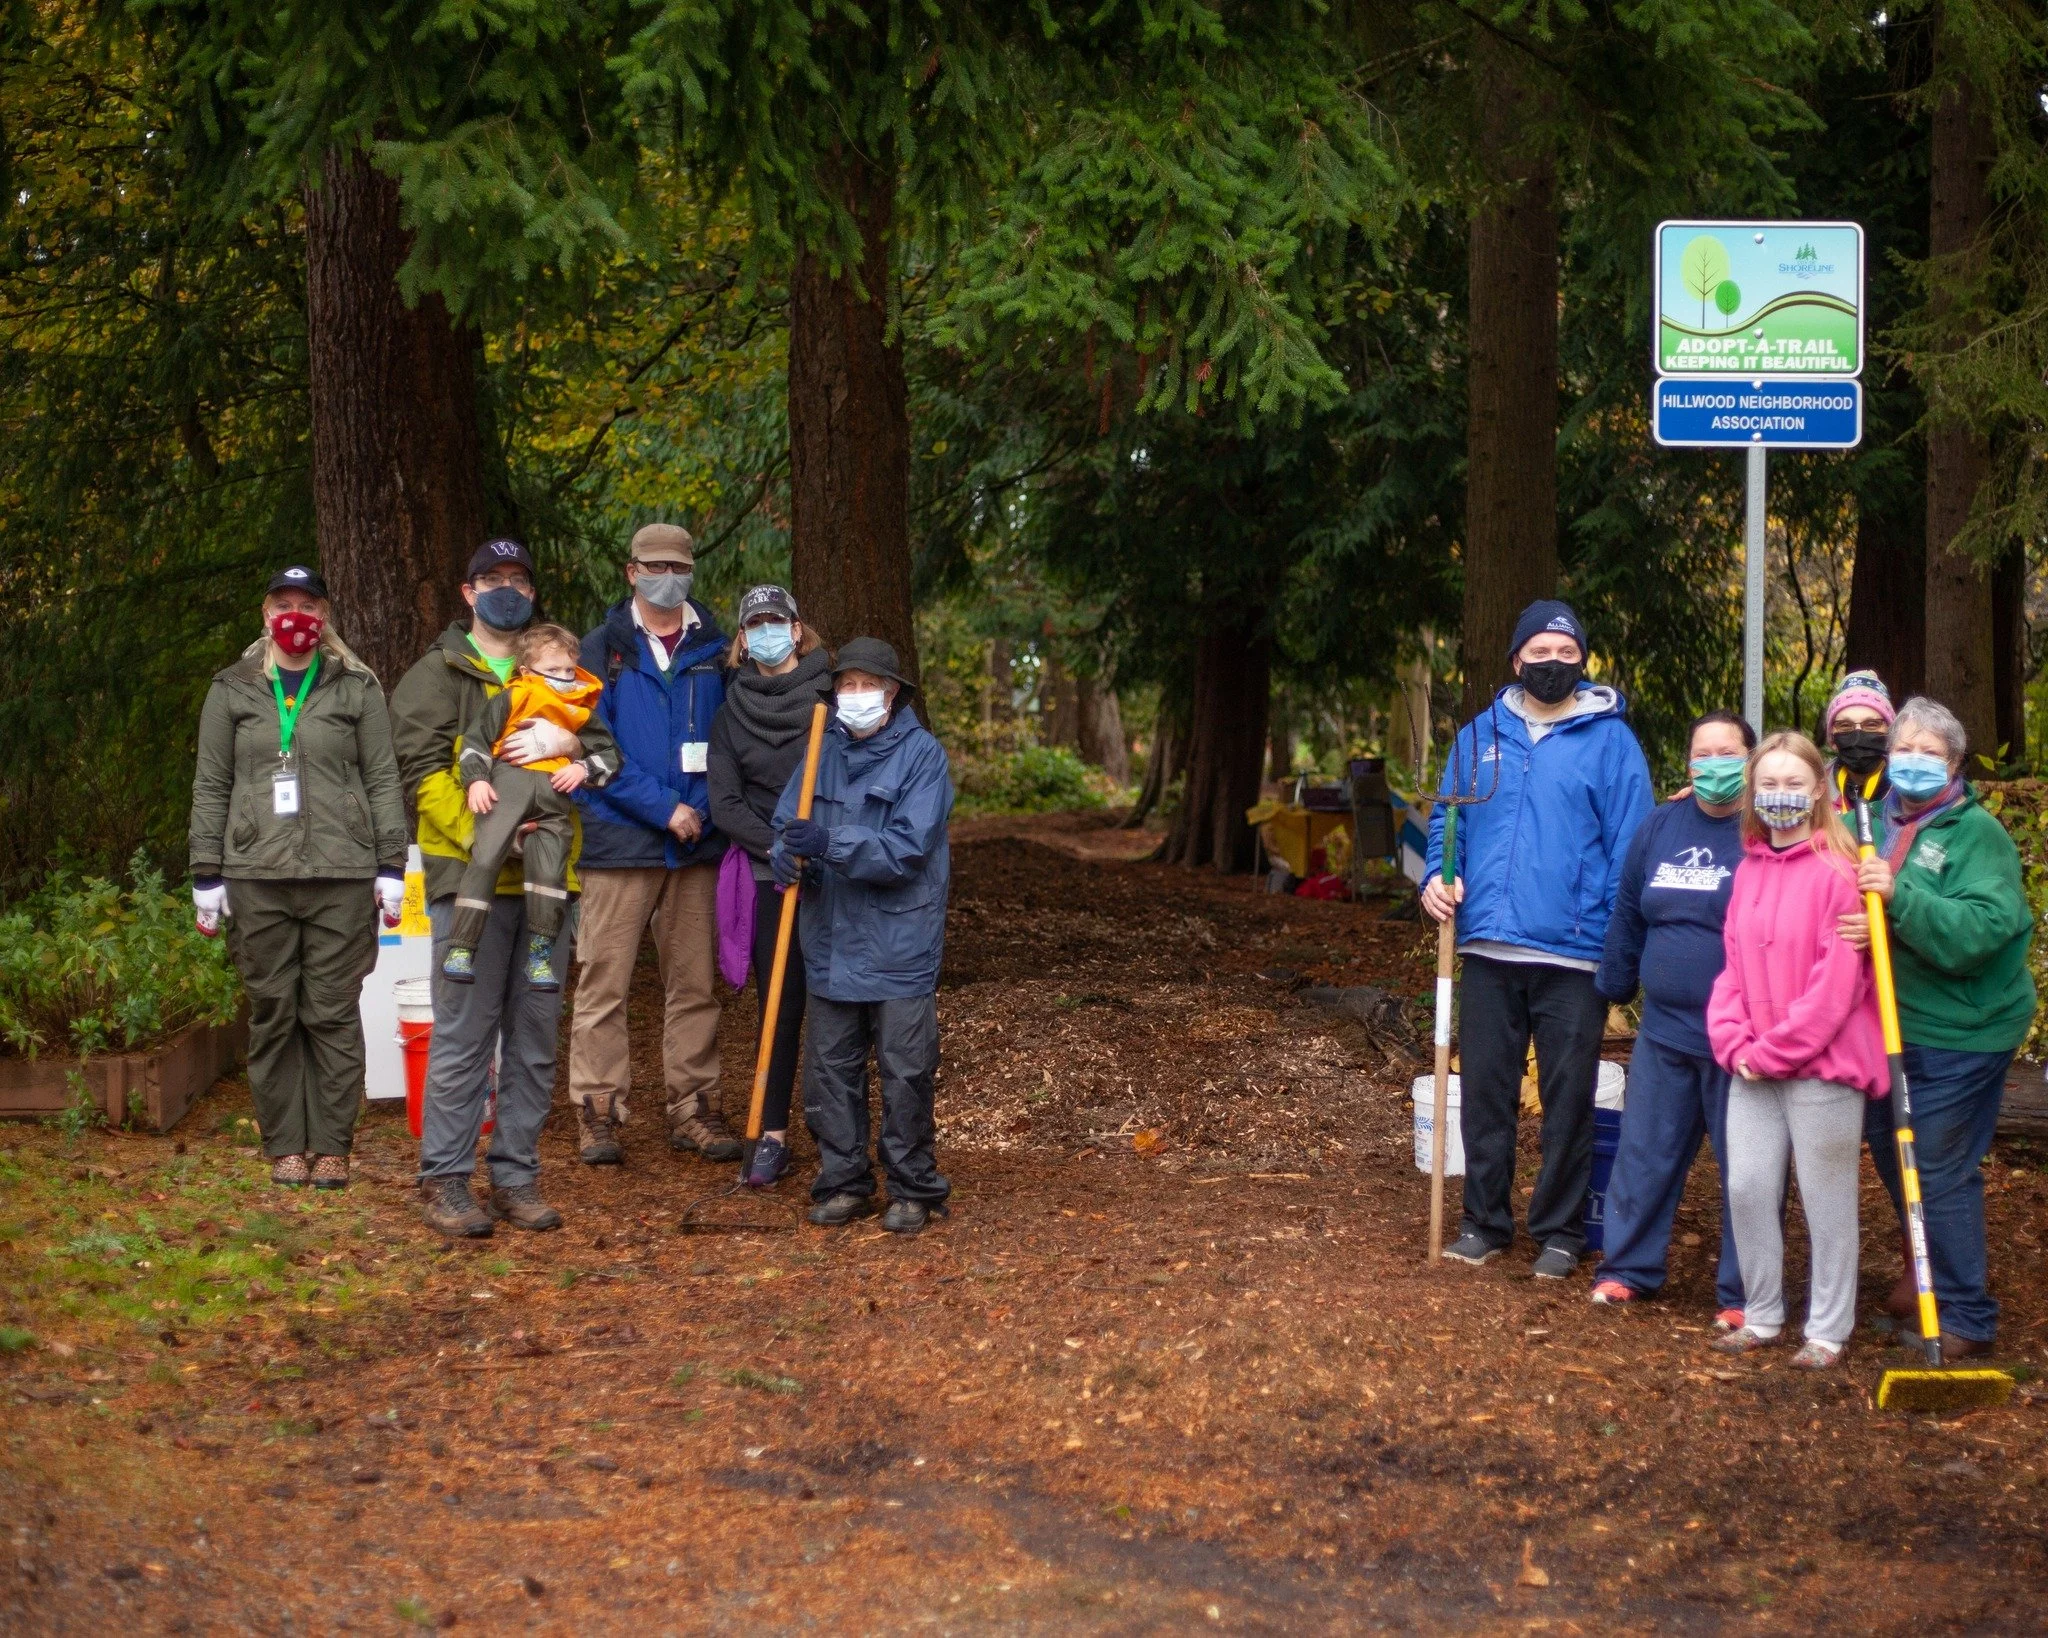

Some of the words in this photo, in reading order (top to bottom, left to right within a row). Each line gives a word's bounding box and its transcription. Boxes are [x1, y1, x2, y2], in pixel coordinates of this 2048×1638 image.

[1778, 263, 1835, 272] SHORELINE
[1676, 338, 1839, 355] ADOPT-A-TRAIL
[1665, 355, 1740, 370] KEEPING
[1743, 356, 1759, 370] IT
[1762, 356, 1852, 370] BEAUTIFUL
[1662, 394, 1736, 409] HILLWOOD
[1739, 395, 1853, 411] NEIGHBORHOOD
[1711, 415, 1805, 430] ASSOCIATION
[490, 541, 518, 557] W
[1687, 876, 1721, 886] NEWS
